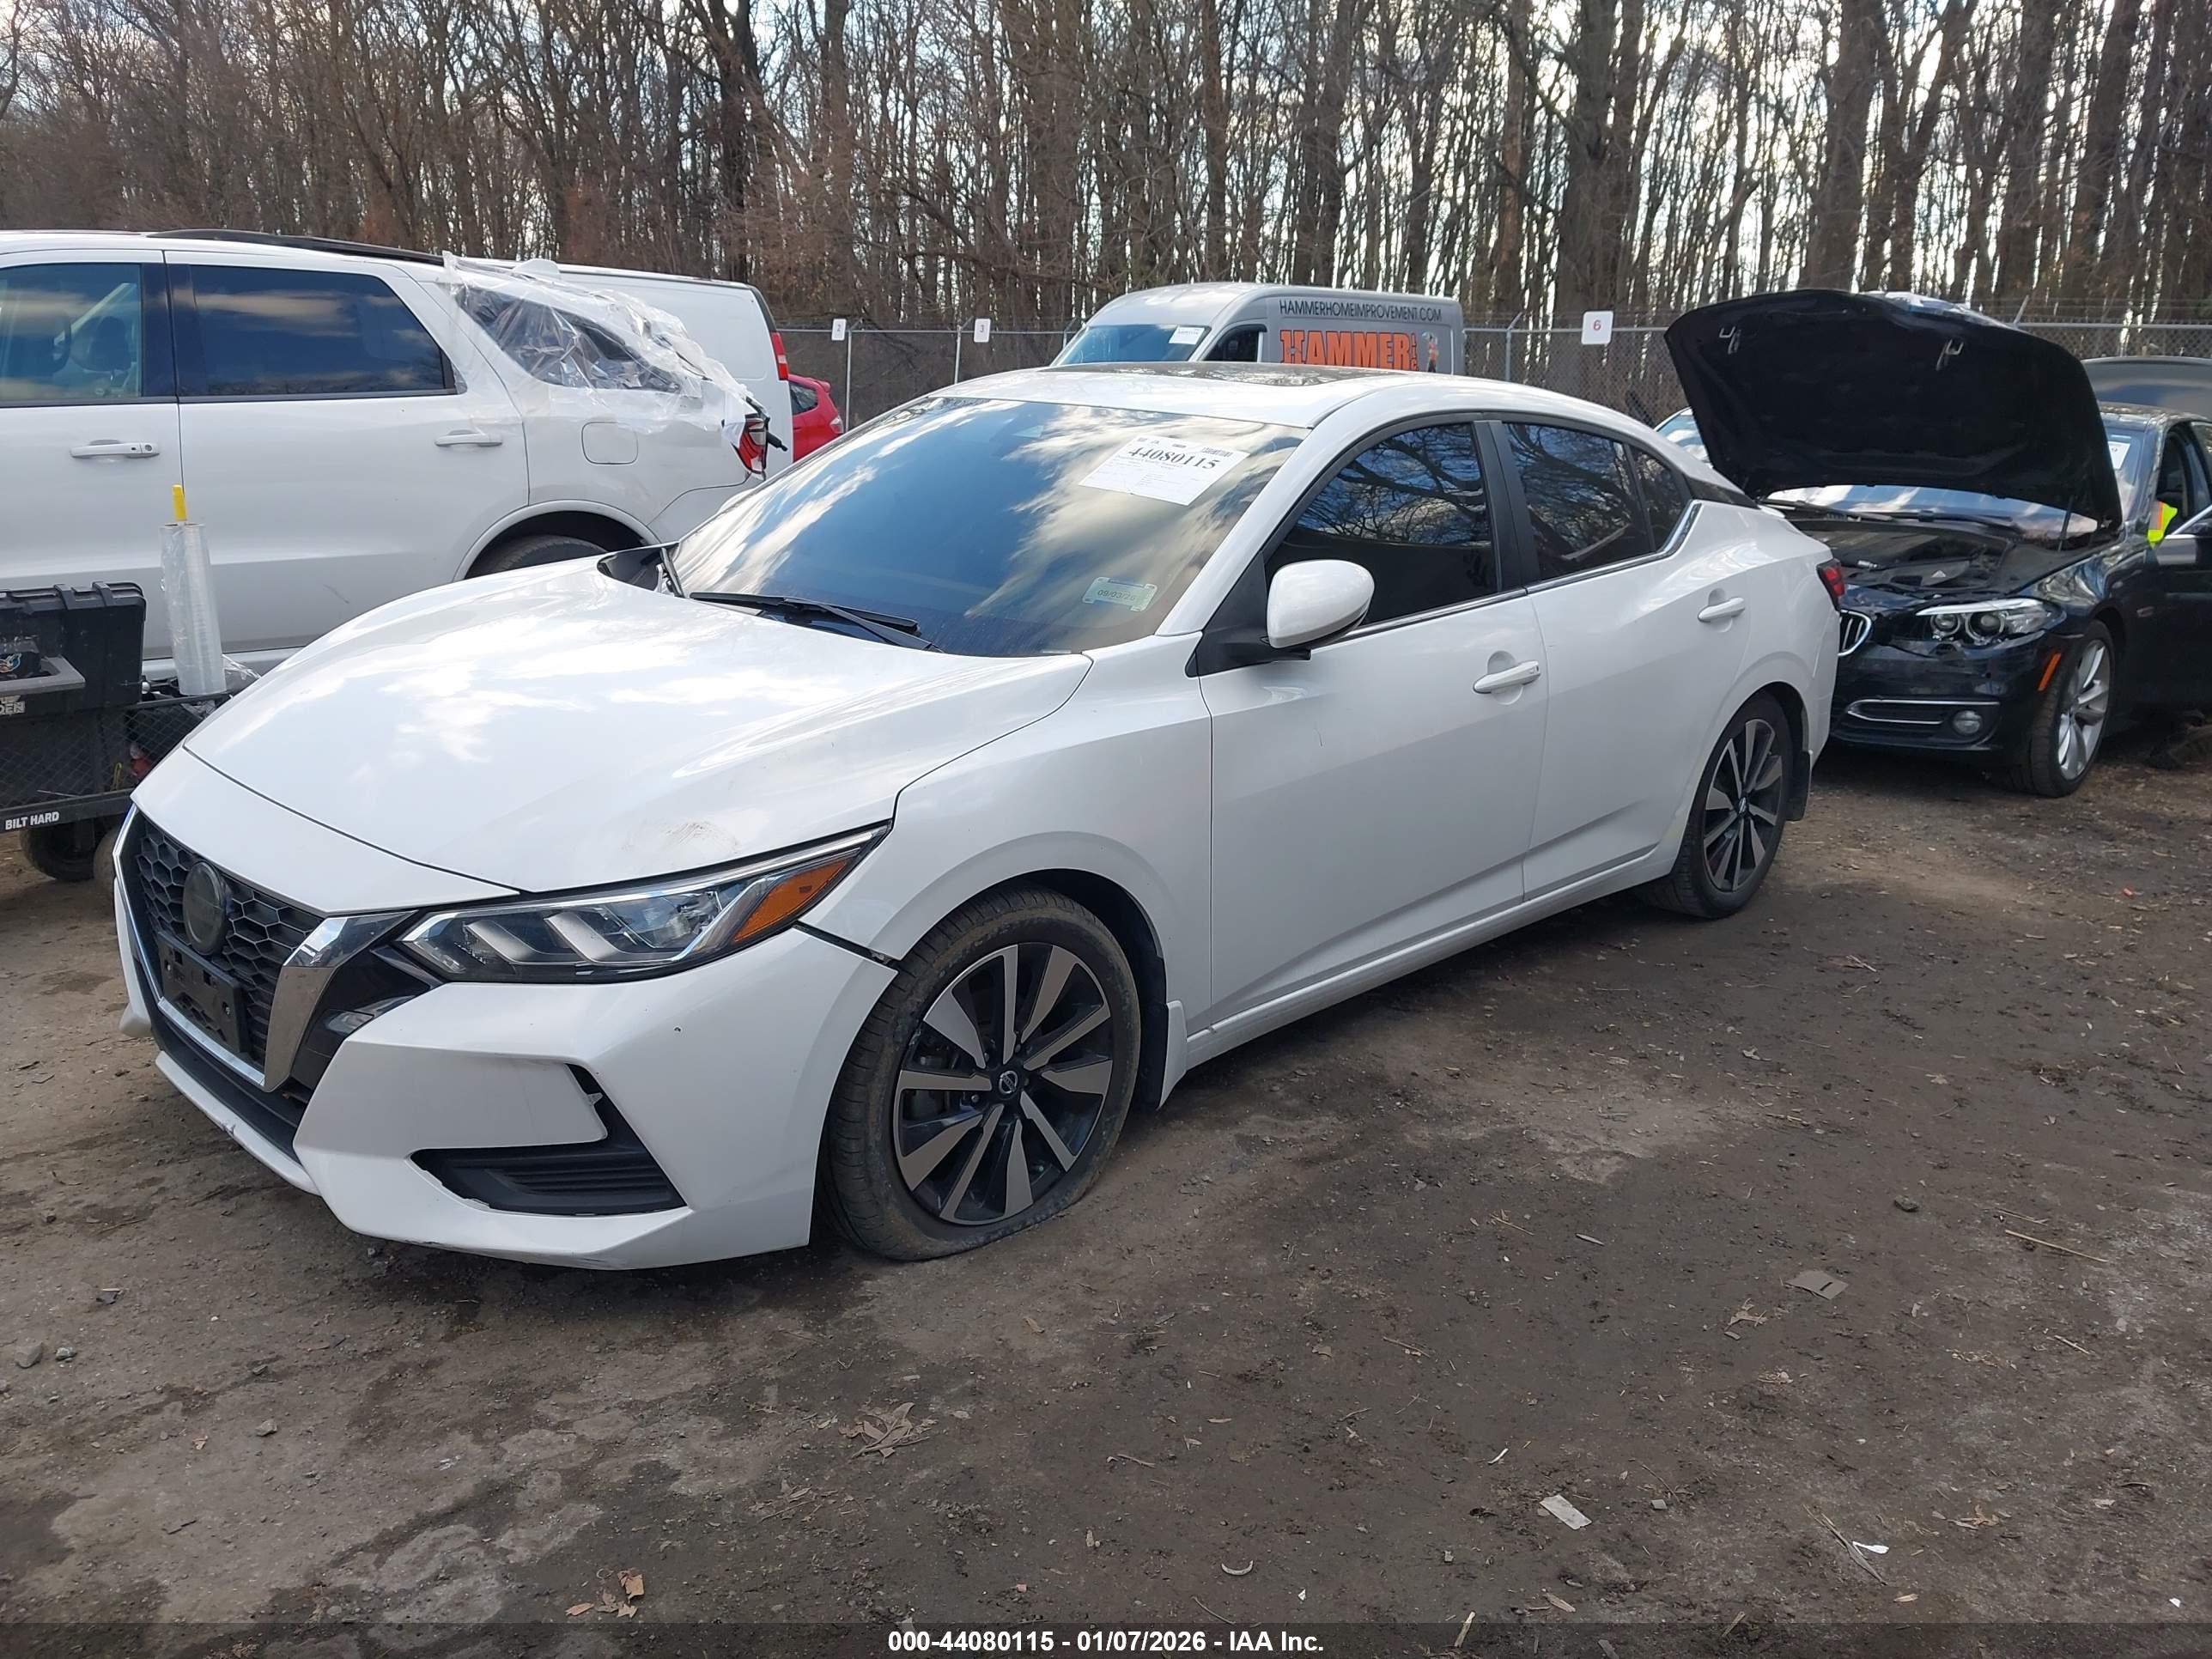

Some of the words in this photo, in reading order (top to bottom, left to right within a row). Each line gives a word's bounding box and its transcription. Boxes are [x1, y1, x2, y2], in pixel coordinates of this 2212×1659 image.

[1279, 300, 1442, 322] HAMMERHOMEIMPROVEMENT.COM
[1593, 319, 1601, 331] 6
[1279, 330, 1410, 371] HAMMER
[1128, 447, 1220, 469] 44080115
[5, 817, 28, 830] BILT
[29, 811, 60, 826] HARD
